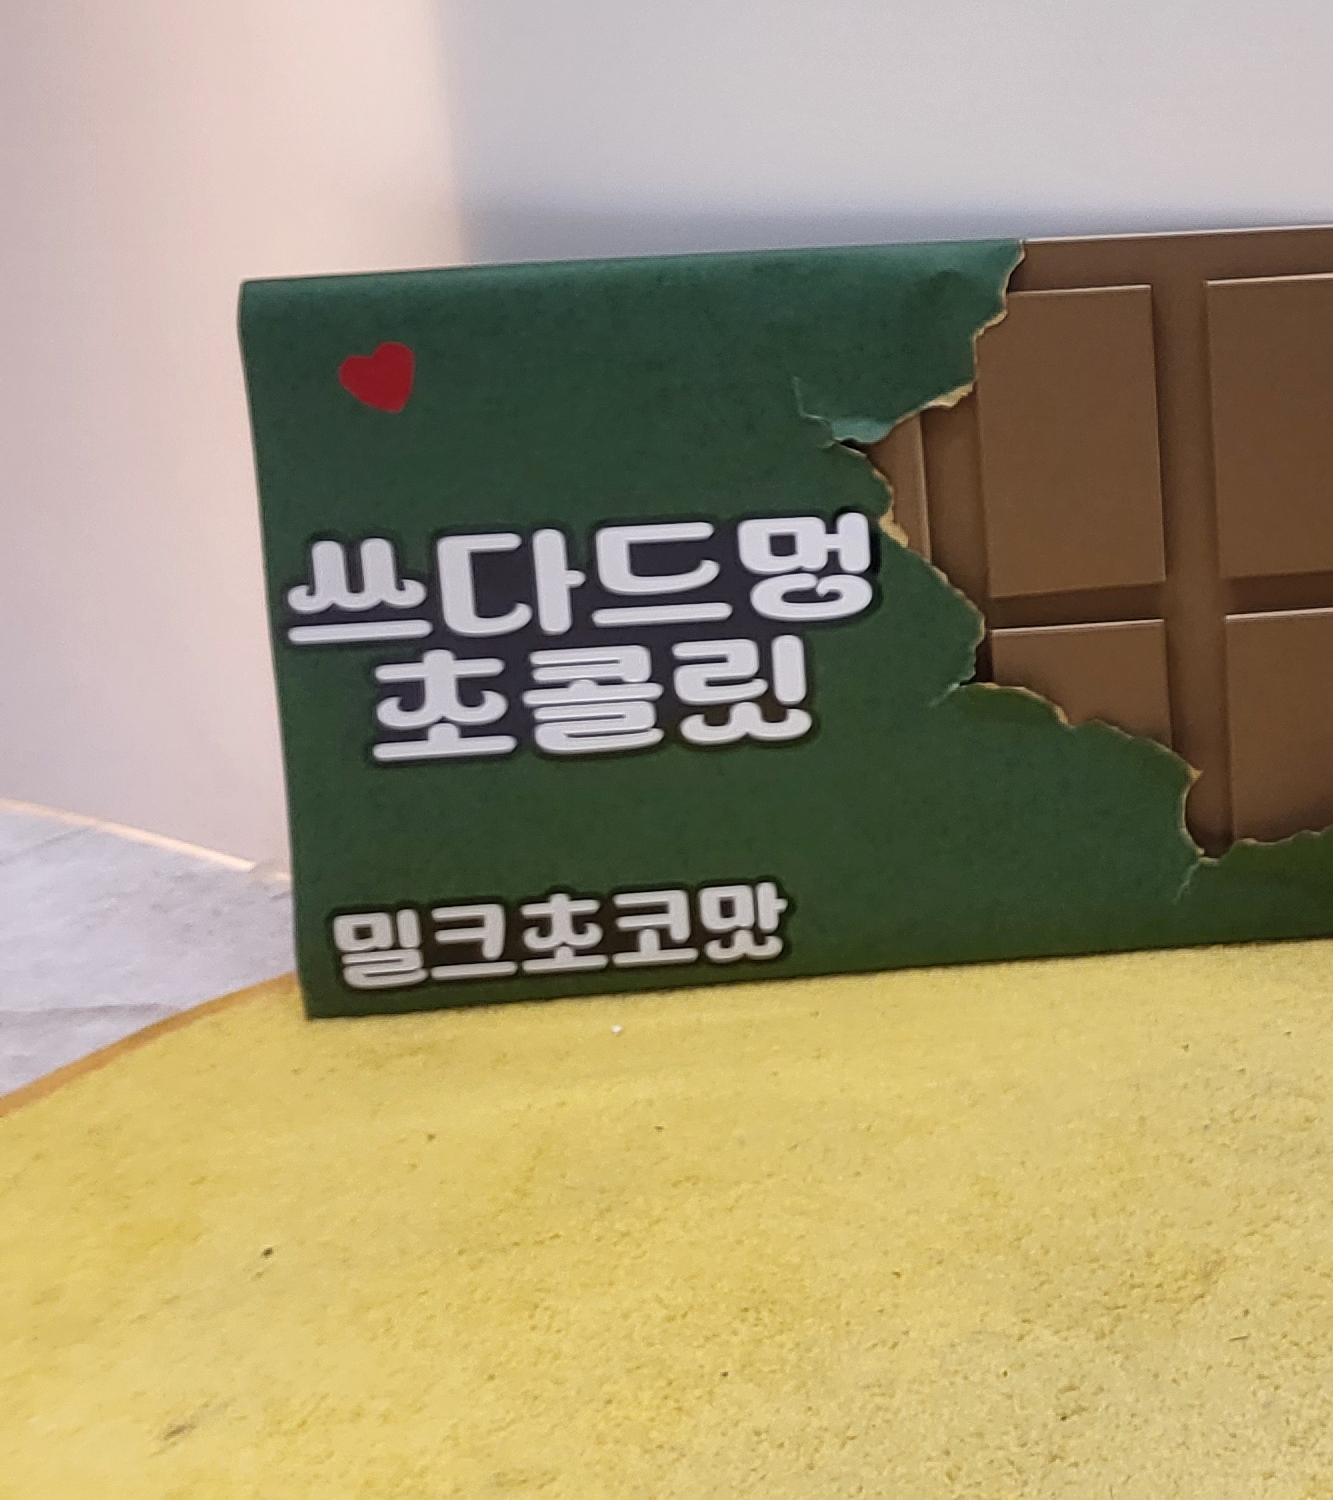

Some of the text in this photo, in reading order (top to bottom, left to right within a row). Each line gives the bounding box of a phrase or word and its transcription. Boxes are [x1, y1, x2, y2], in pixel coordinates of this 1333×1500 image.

[285, 509, 880, 645] 쓰다드멍
[370, 634, 815, 764] 초콜릿
[331, 879, 790, 991] 밀크초코맛
